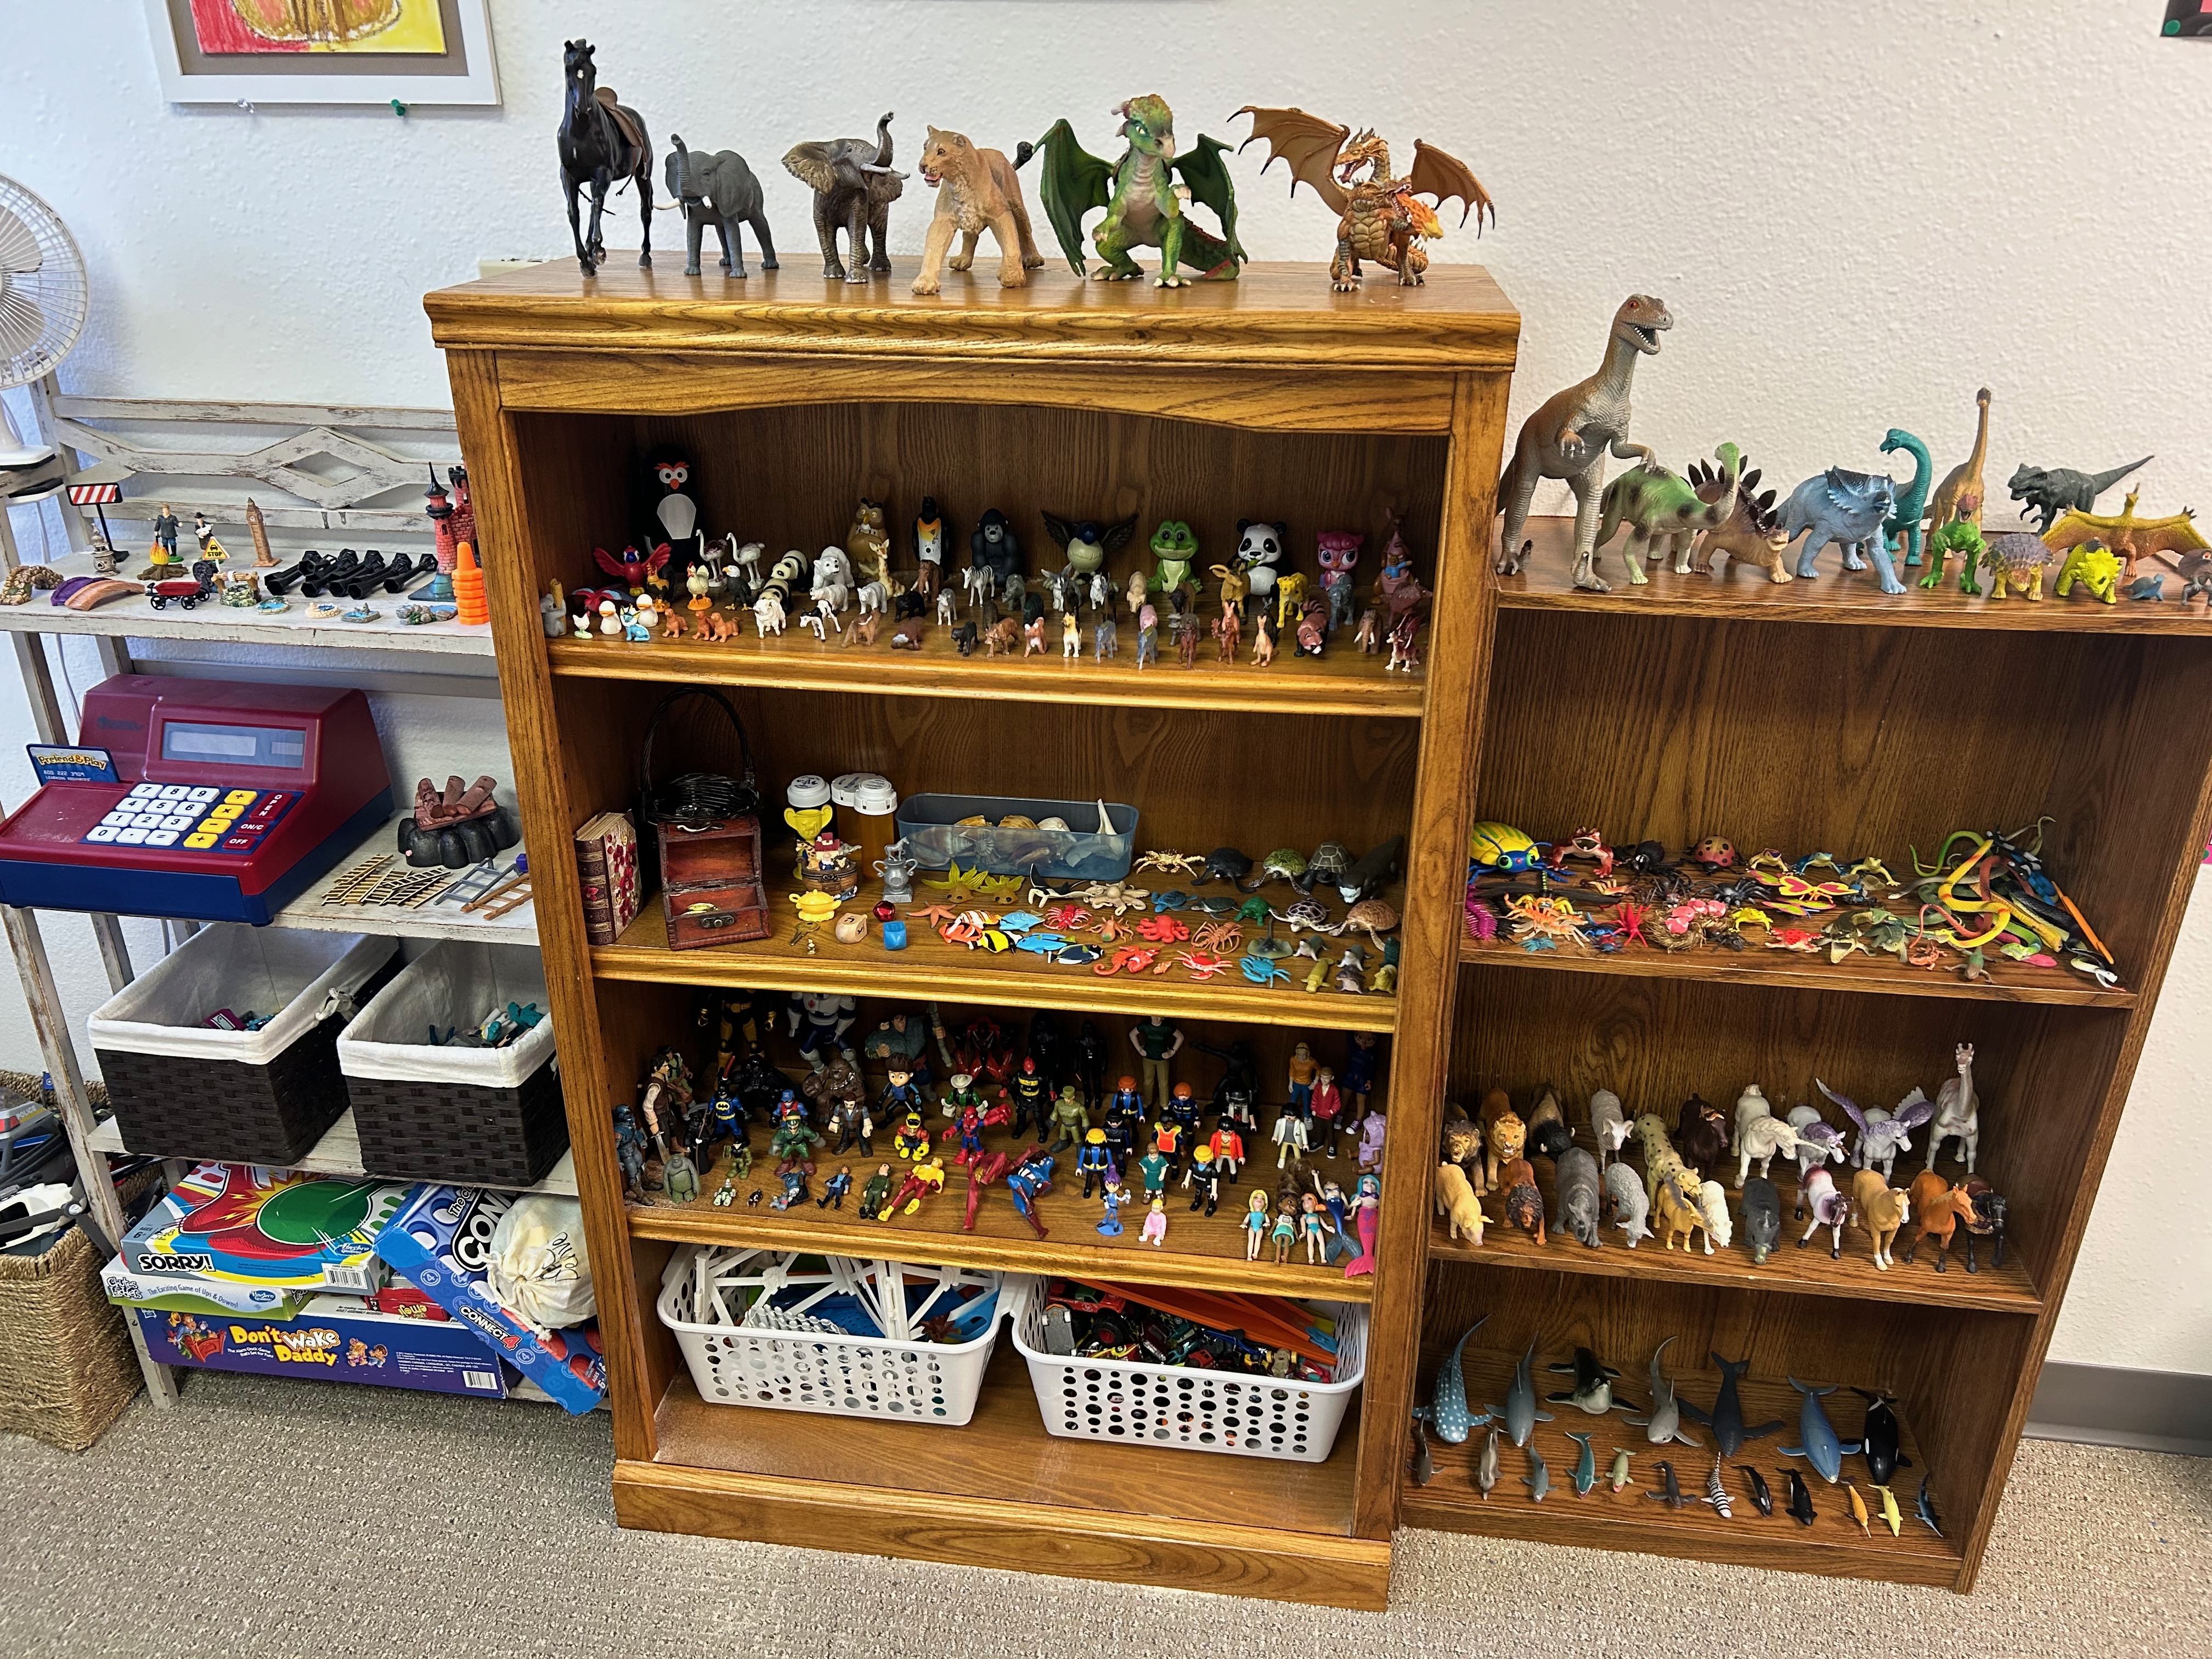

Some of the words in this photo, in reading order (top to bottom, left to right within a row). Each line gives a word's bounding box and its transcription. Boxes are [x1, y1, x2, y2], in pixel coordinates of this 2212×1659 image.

[38, 754, 75, 765] Pretend
[84, 755, 106, 769] Play
[258, 794, 283, 816] OPEN
[16, 1104, 37, 1120] POLICE
[449, 1197, 465, 1217] The
[340, 1243, 370, 1251] Hasbro
[139, 1255, 214, 1271] SORRY!
[107, 1277, 138, 1289] Chutes
[109, 1286, 143, 1299] Ladders
[147, 1287, 157, 1295] The
[202, 1288, 212, 1298] Ups
[218, 1295, 239, 1308] Downs!
[398, 1304, 427, 1316] emoji
[460, 1306, 509, 1341] CONNECT
[503, 1335, 522, 1350] 4
[229, 1325, 281, 1344] Don't
[283, 1330, 339, 1350] Wake
[274, 1345, 337, 1366] Daddy
[591, 1372, 600, 1384] AGES
